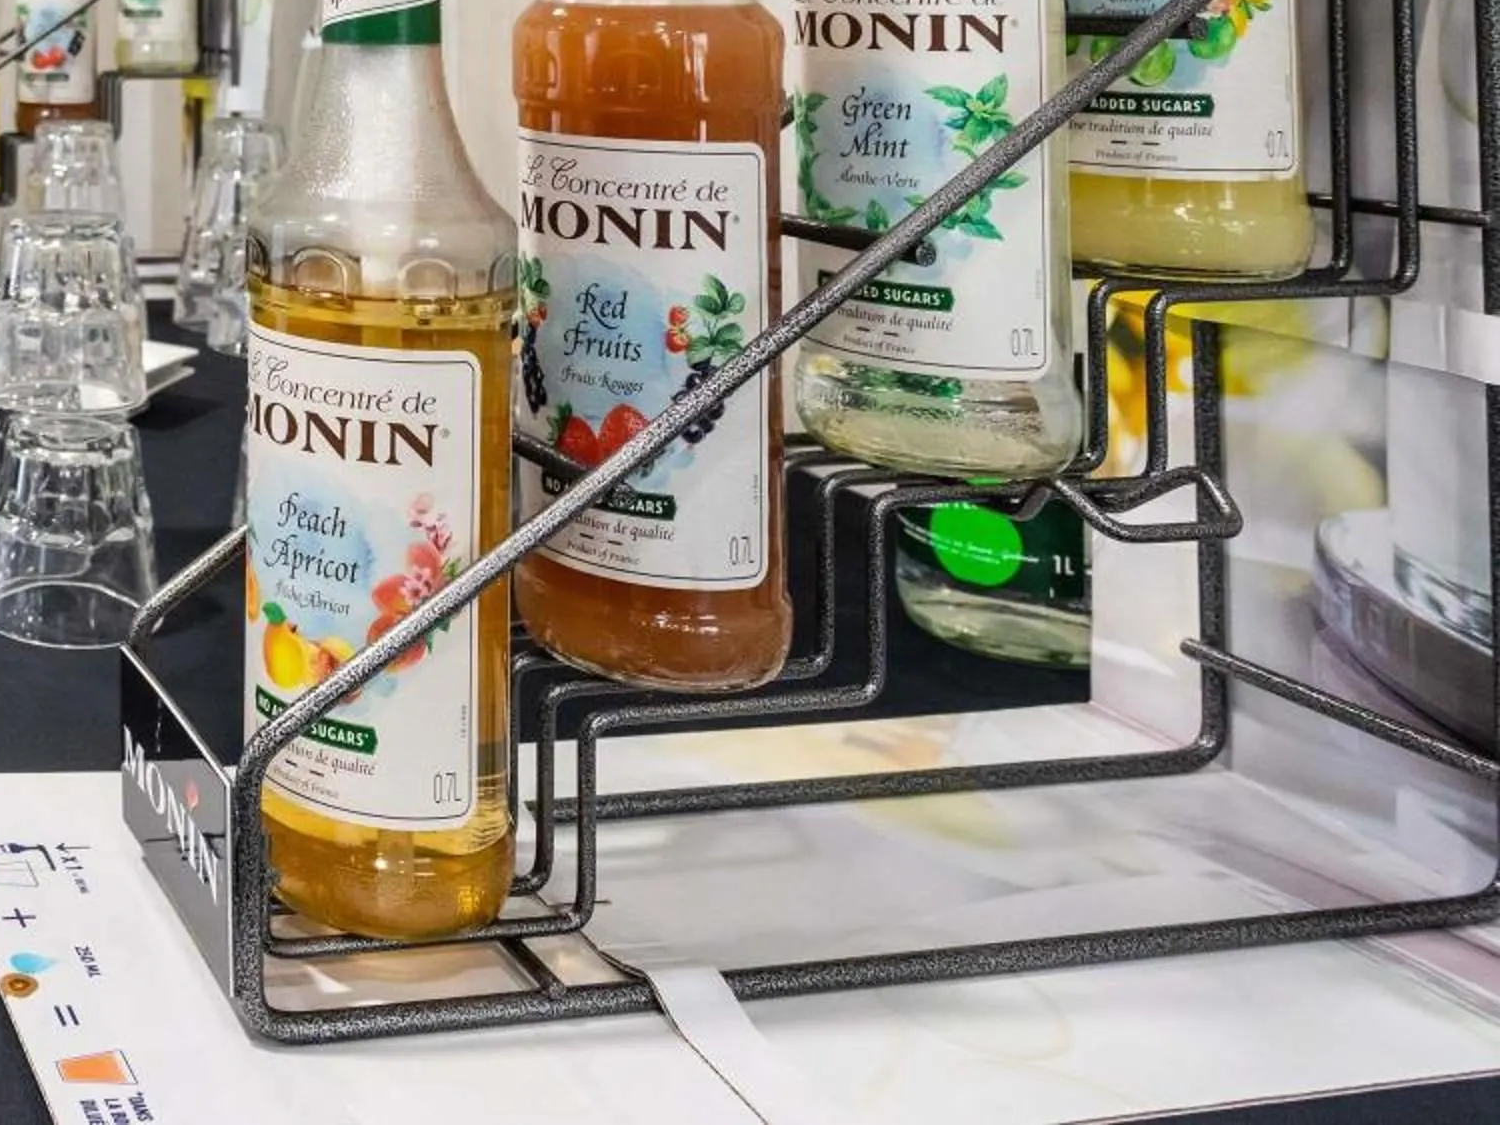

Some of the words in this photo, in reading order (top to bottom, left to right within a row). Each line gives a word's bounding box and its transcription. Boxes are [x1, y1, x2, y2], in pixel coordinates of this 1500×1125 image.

[794, 11, 1009, 53] MONIN
[841, 86, 911, 125] Green
[1090, 97, 1137, 111] ADDED
[840, 123, 910, 158] Mint
[550, 157, 687, 202] Concentré
[696, 181, 729, 202] de
[521, 191, 731, 252] MONIN
[575, 283, 629, 329] Red
[563, 321, 643, 362] Fruits
[266, 355, 392, 412] Concentré
[401, 391, 436, 414] de
[277, 492, 348, 538] Peach
[264, 535, 360, 583] Apricot
[1052, 555, 1075, 576] 1L
[124, 724, 219, 906] MONIN
